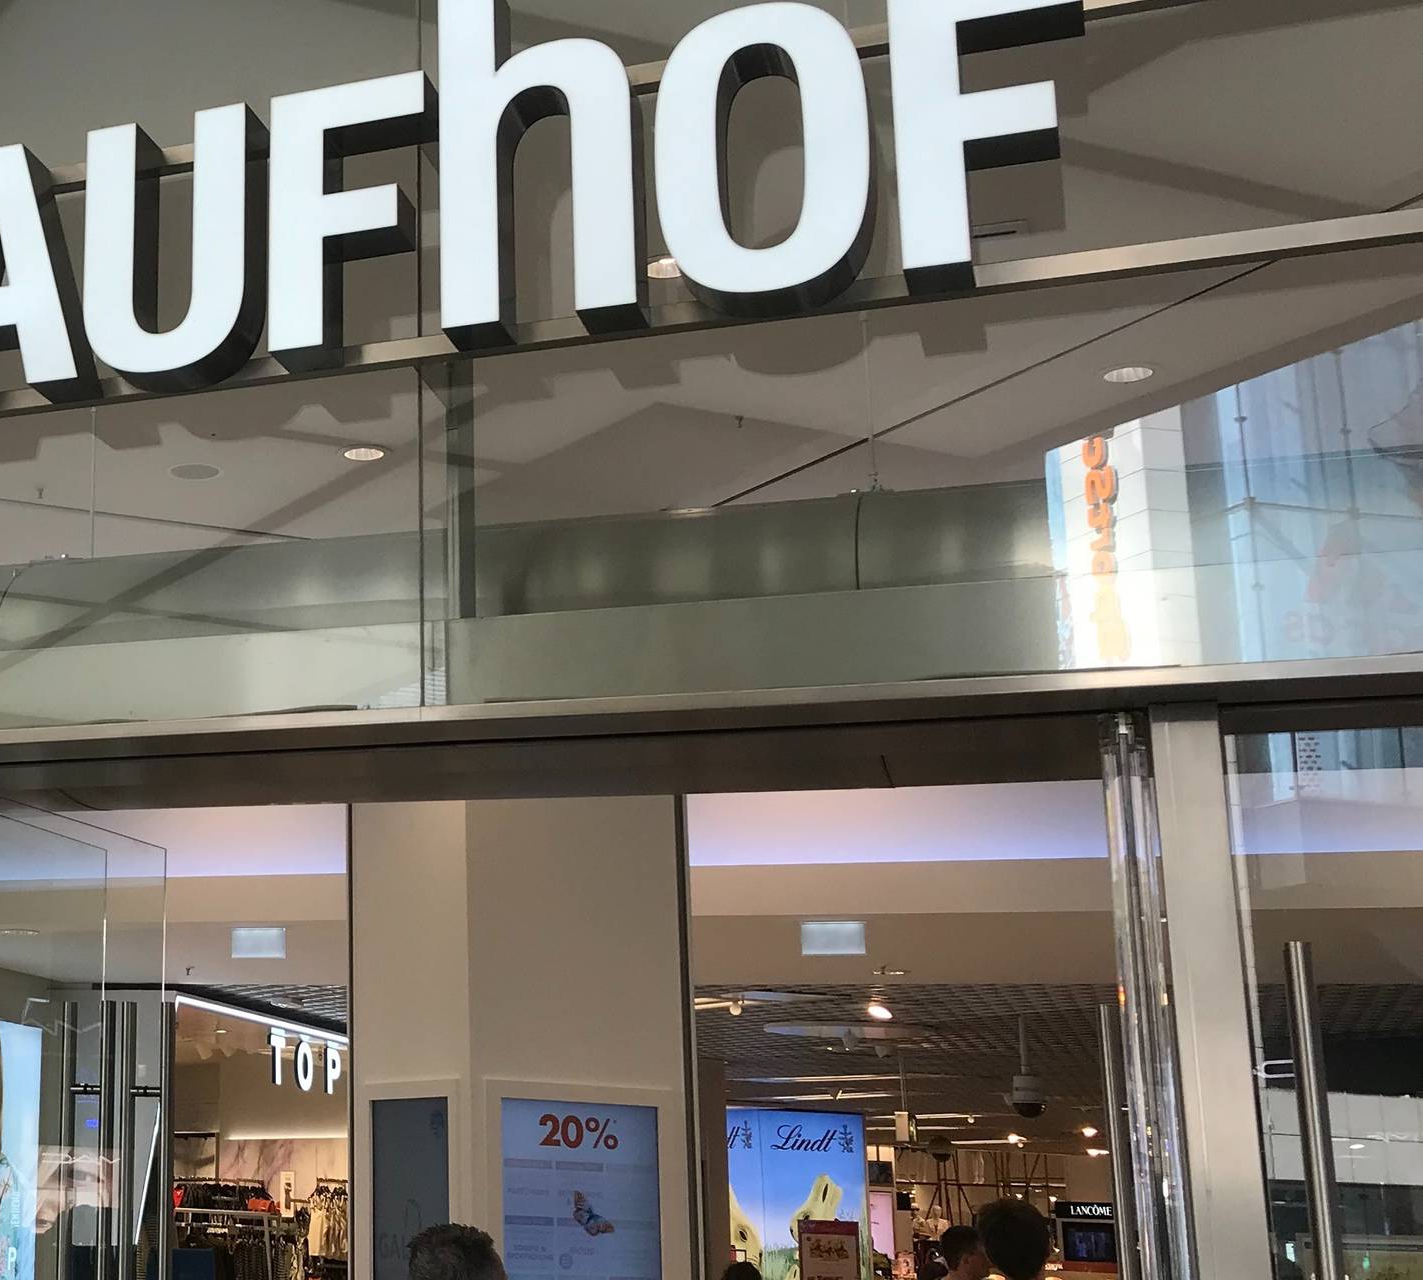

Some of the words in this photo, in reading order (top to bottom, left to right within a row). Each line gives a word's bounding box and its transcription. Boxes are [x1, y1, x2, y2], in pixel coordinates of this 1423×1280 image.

[270, 1033, 341, 1095] TOP
[539, 1113, 619, 1150] 20%
[770, 1124, 837, 1152] Lindt
[1070, 1204, 1113, 1217] LANCÔME
